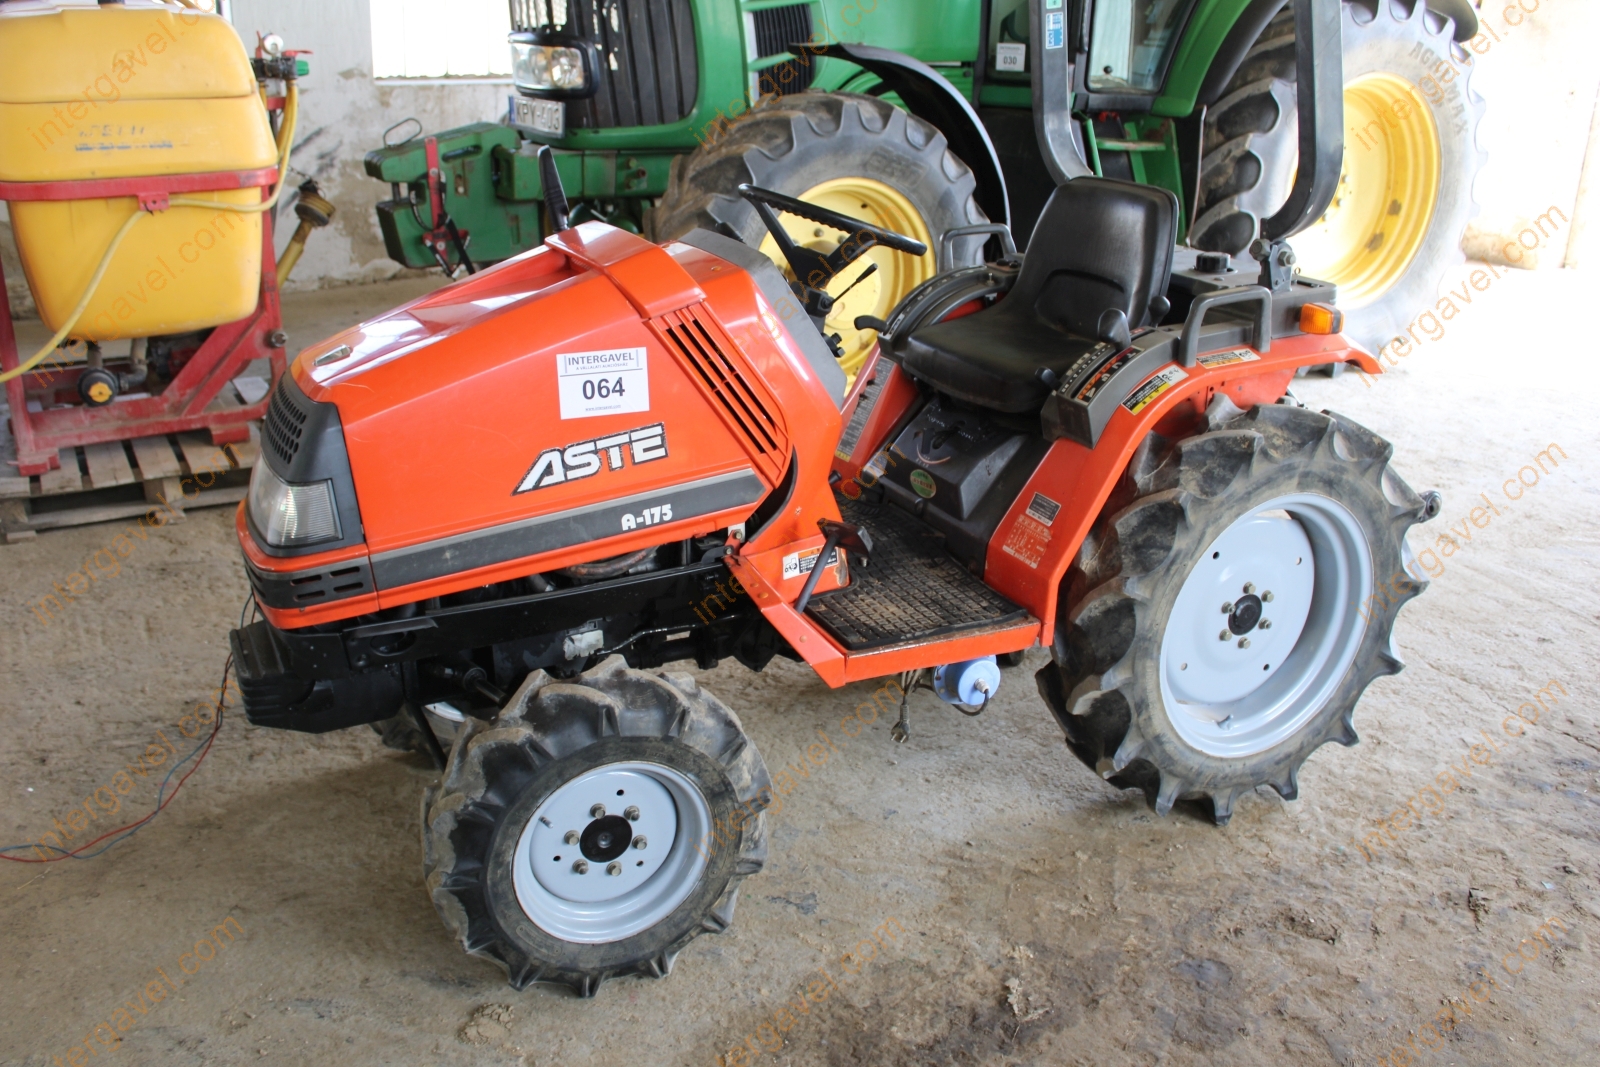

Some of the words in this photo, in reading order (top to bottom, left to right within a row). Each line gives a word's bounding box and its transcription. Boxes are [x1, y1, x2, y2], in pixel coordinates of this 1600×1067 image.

[1003, 55, 1018, 65] 030
[516, 100, 560, 130] KPY-403
[568, 352, 635, 366] INTERGAVEL
[582, 376, 625, 400] 064
[510, 422, 668, 496] ASTE
[621, 503, 673, 531] A-175
